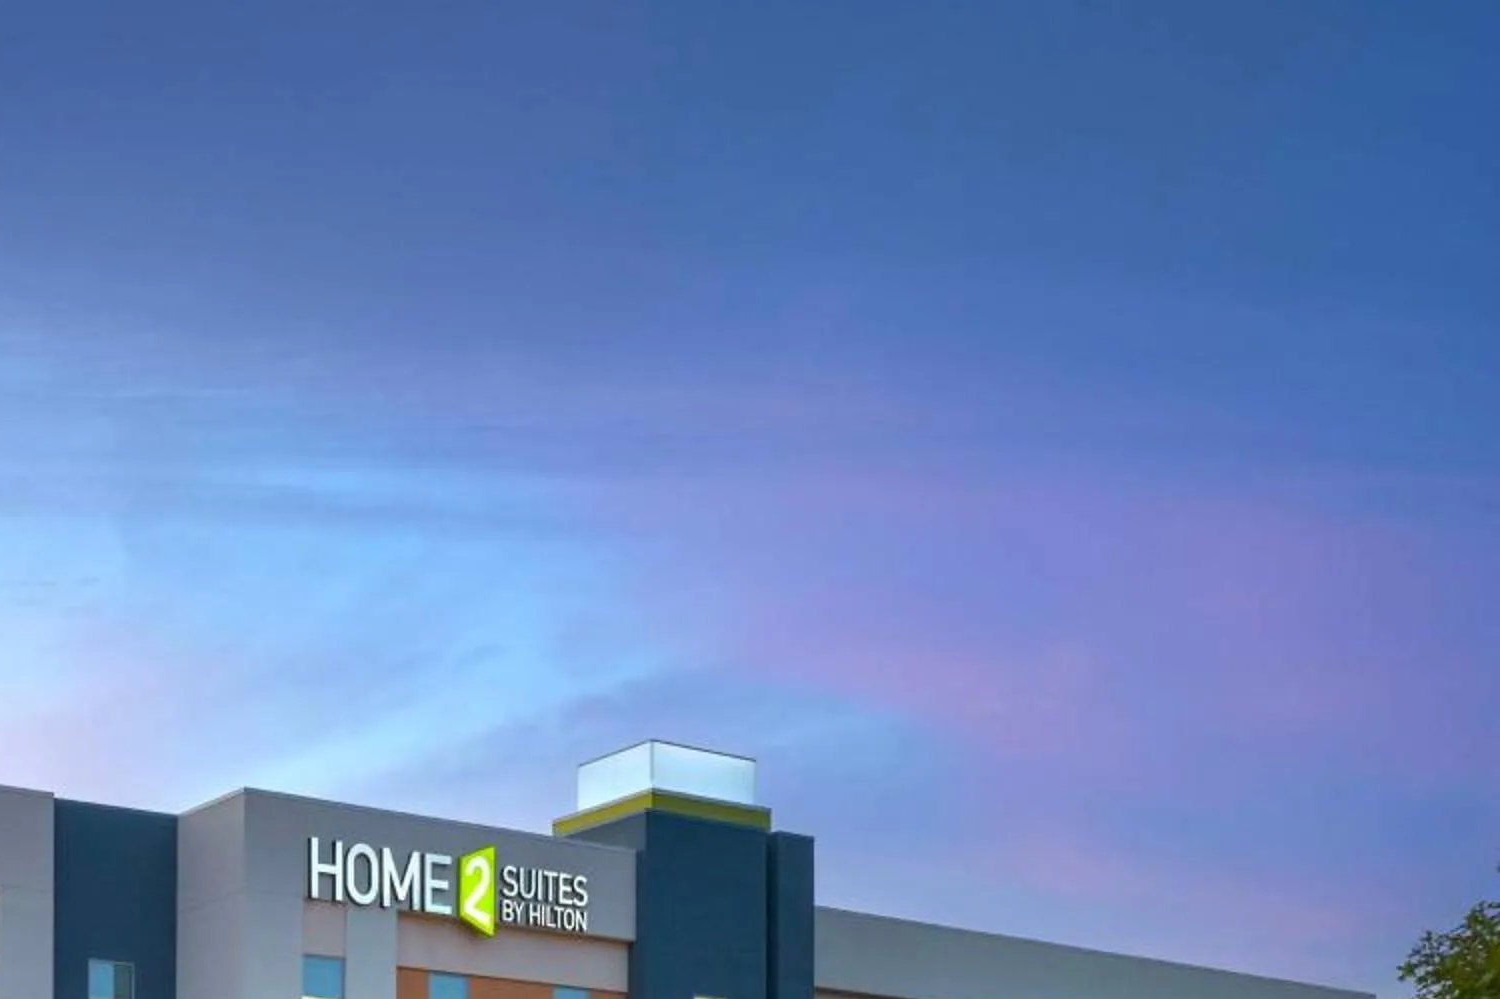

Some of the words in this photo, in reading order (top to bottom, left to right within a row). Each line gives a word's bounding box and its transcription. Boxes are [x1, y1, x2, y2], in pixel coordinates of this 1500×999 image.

[310, 836, 453, 915] HOME
[463, 855, 491, 926] 2
[501, 866, 589, 907] SUITES
[501, 900, 523, 923] BY
[529, 904, 588, 932] HILTON
